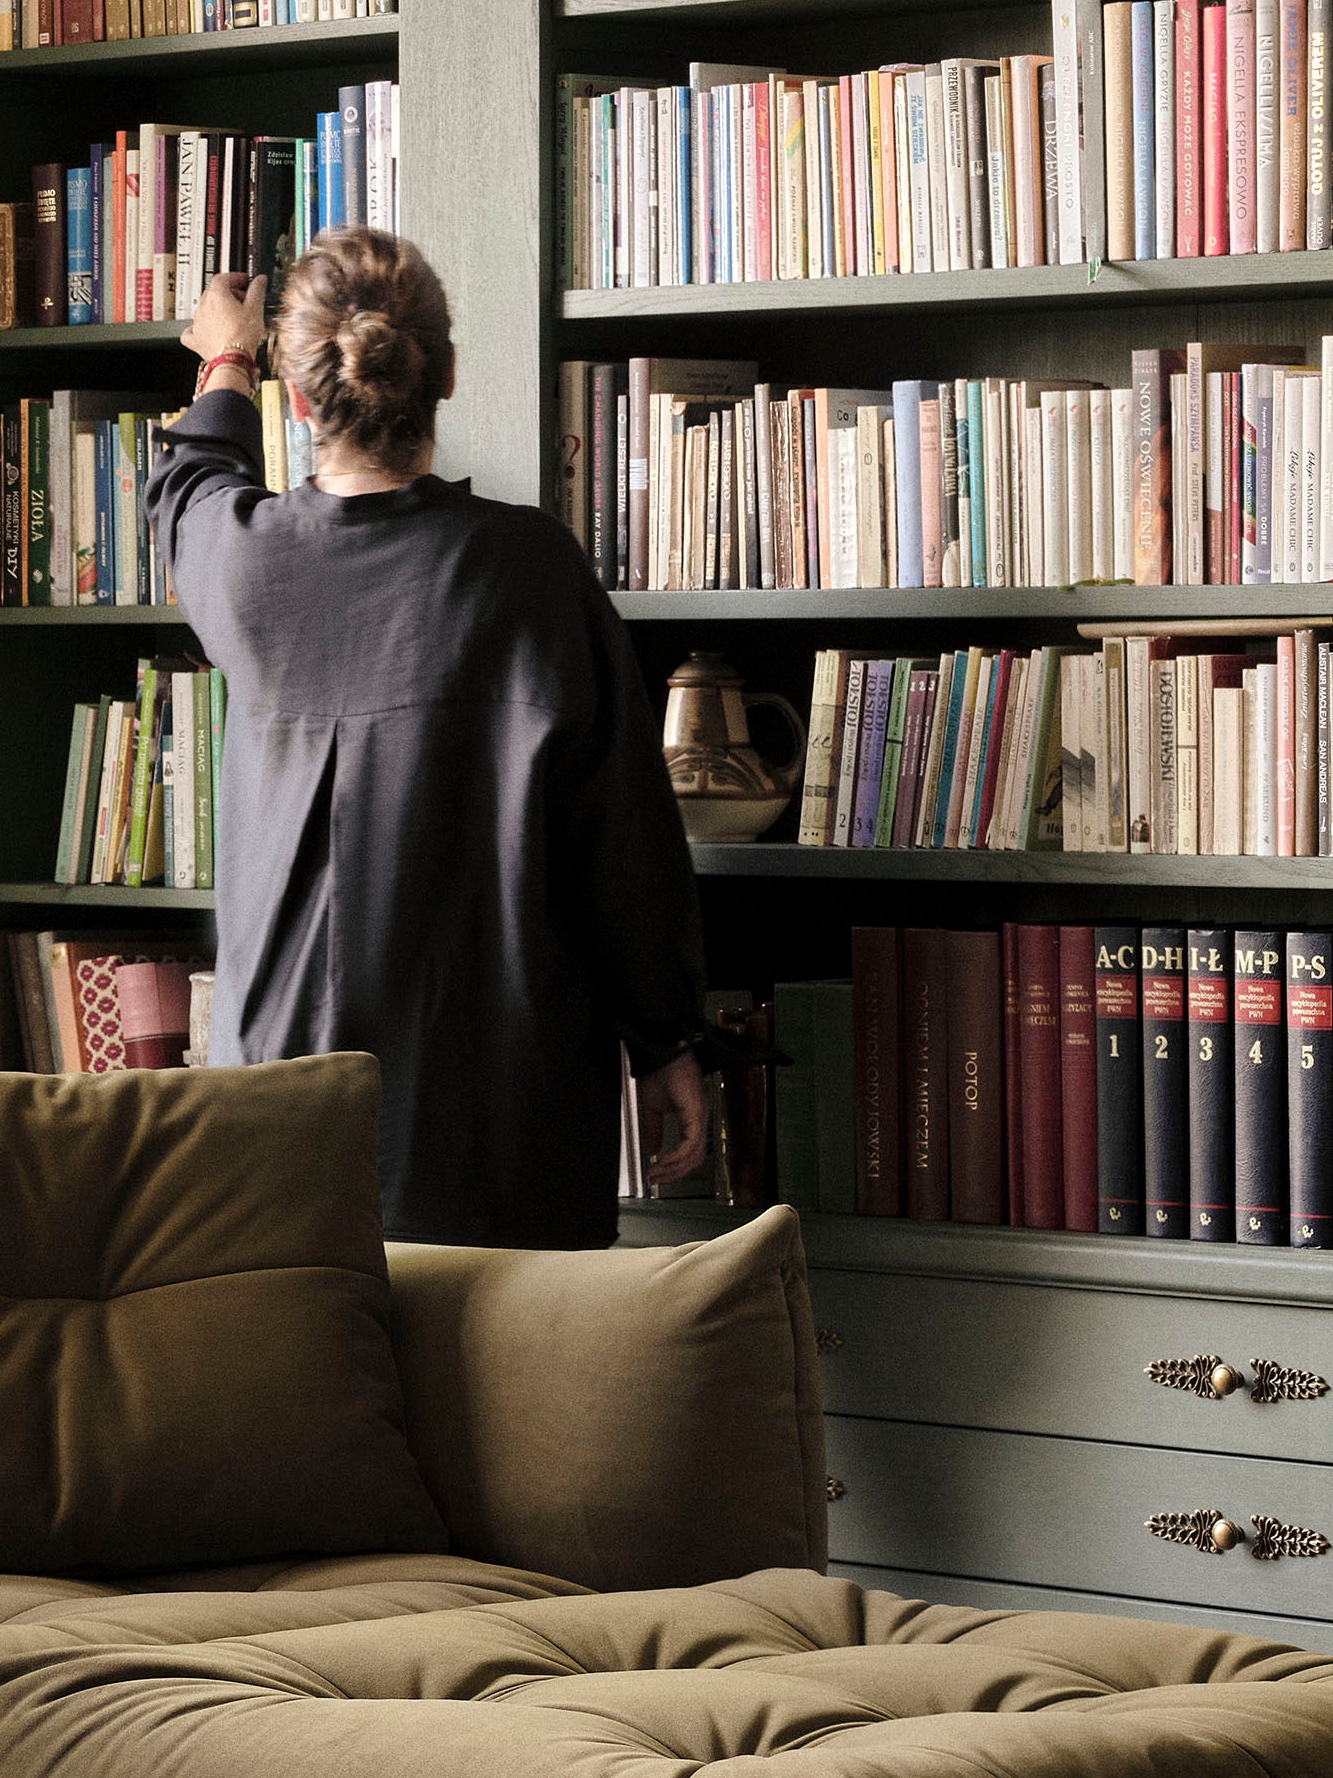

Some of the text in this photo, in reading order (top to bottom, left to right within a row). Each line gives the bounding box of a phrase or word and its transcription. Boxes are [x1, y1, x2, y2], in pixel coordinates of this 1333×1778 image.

[1159, 14, 1170, 111] NIGELLA GRYZIE
[1286, 4, 1297, 116] JAMIE OLIVER
[1312, 32, 1323, 119] OLIVEREM
[948, 67, 958, 113] PRZEWODNIK
[1259, 35, 1273, 166] NIGELLISSIMA
[1184, 71, 1194, 216] KAŻDY MOŻE GOTOWAĆ
[1235, 37, 1247, 219] NIGELLA EKSPRESOWO
[992, 156, 1000, 183] Jakie
[1045, 120, 1058, 201] DRZEWA
[1292, 122, 1302, 219] włoska wyprawa
[1312, 139, 1324, 195] GOTUJ
[179, 139, 193, 266] JAN PAWEŁ II
[993, 187, 1000, 195] to
[1190, 357, 1199, 400] PARADOKS
[1140, 382, 1154, 550] NOWE OŚWIECENIE
[31, 490, 44, 542] ZIOŁA
[618, 475, 626, 513] WIELKI
[594, 513, 602, 558] RAY DALIO
[7, 547, 17, 579] DIY
[848, 669, 861, 728] TOŁSTOJ
[1160, 671, 1174, 782] DOSTOJEWSKI
[1096, 945, 1134, 970] A-C
[1142, 946, 1184, 970] D-H
[1191, 948, 1223, 971] I-Ł
[1236, 949, 1279, 974] M-P
[1292, 955, 1326, 979] P-S
[1300, 991, 1316, 999] Nowa
[1109, 1035, 1119, 1057] 1
[1155, 1036, 1168, 1059] 2
[1199, 1038, 1213, 1061] 3
[1249, 1040, 1263, 1064] 4
[1301, 1045, 1315, 1068] 5
[965, 1051, 978, 1110] POTOP
